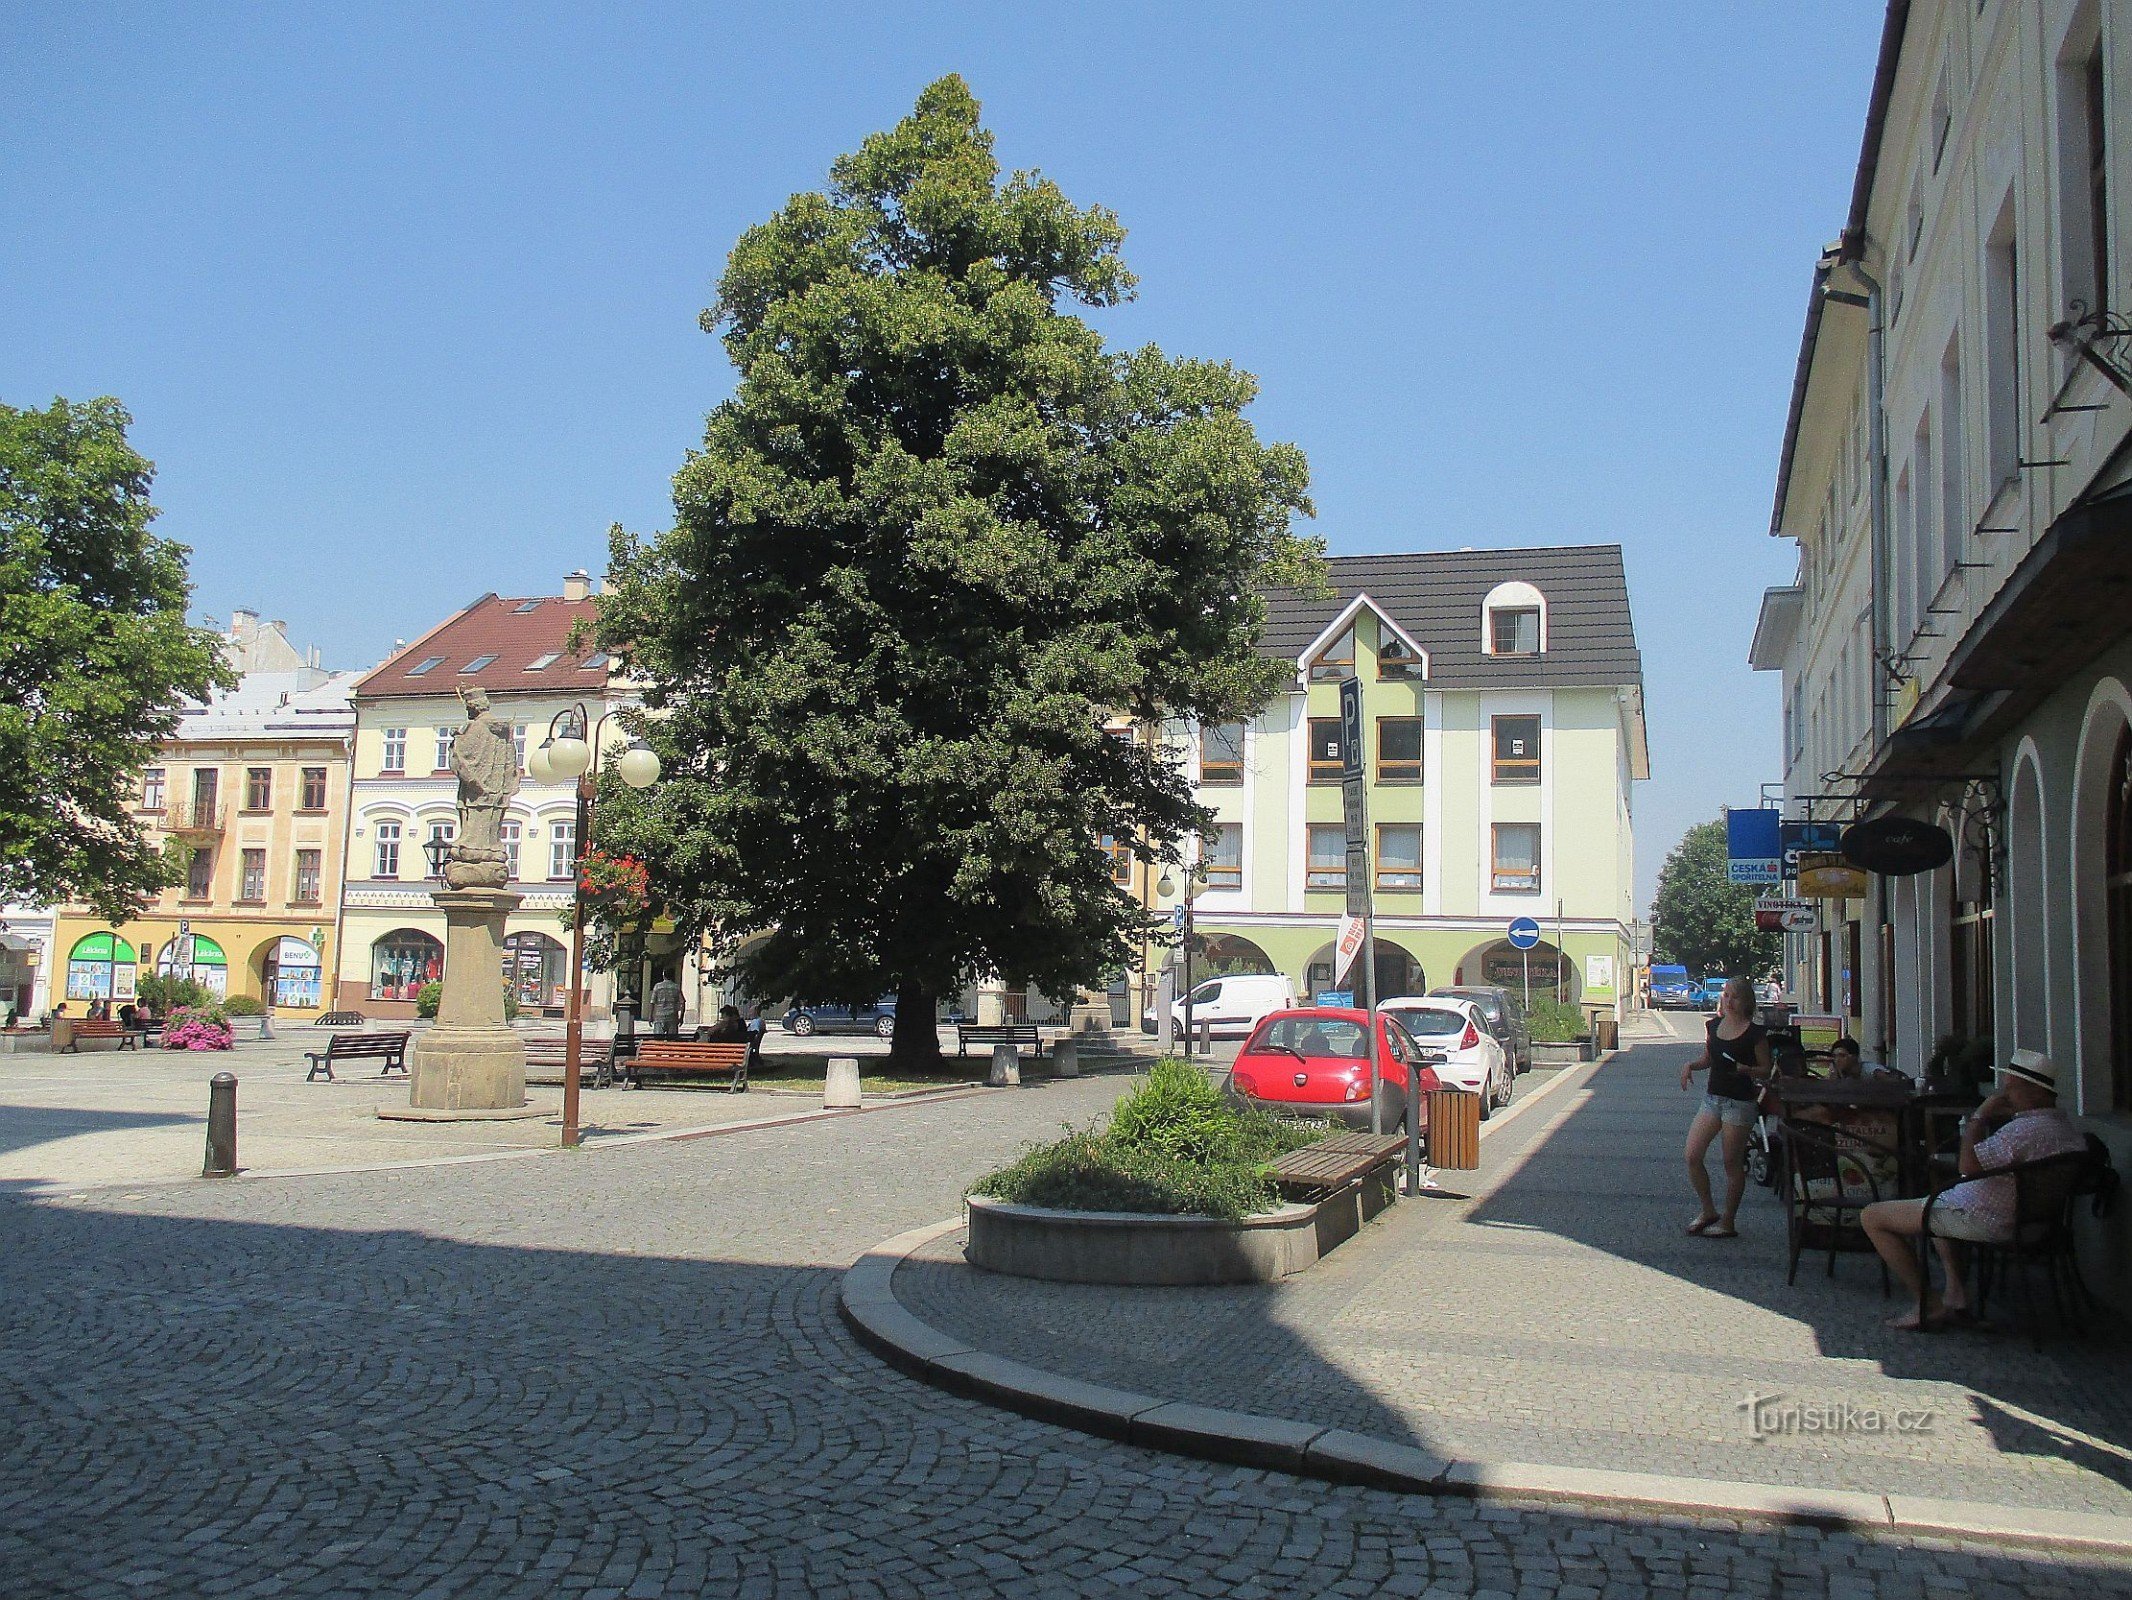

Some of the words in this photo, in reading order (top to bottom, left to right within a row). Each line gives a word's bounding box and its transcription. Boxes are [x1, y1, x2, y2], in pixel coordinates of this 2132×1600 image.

[1343, 693, 1356, 745] P
[1731, 862, 1766, 873] ČESKÁ
[284, 951, 303, 959] BENU
